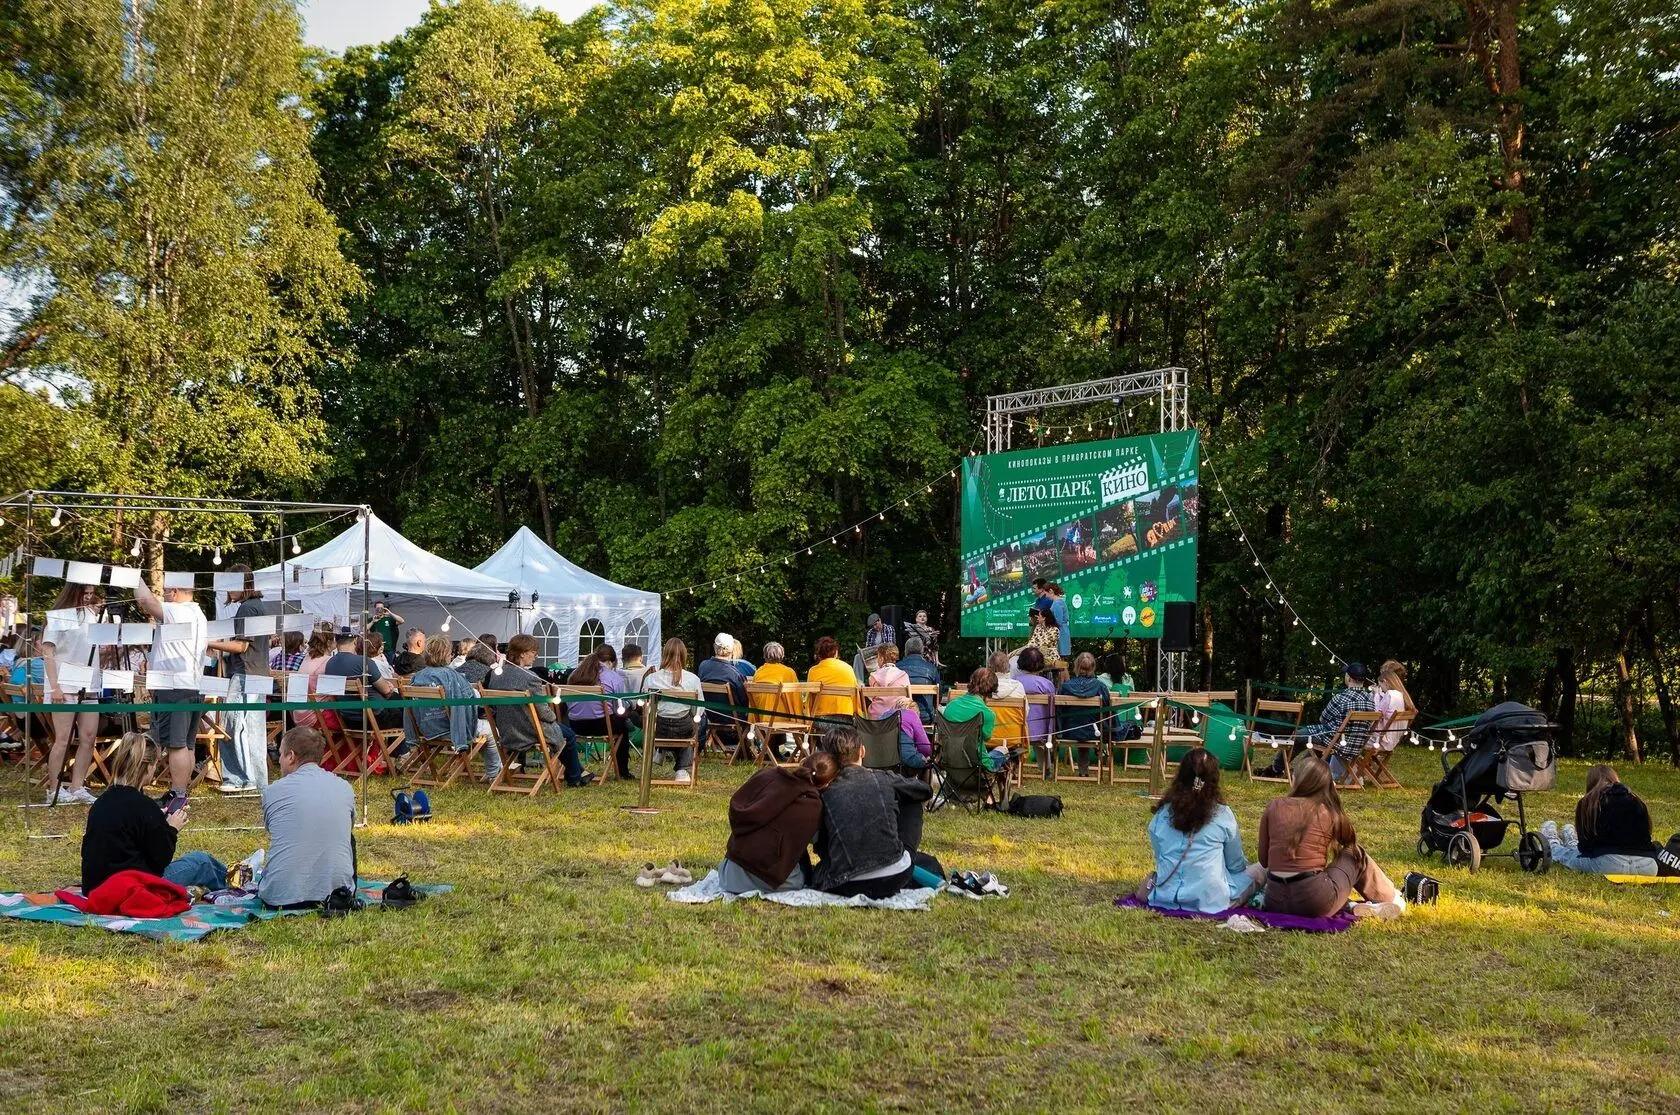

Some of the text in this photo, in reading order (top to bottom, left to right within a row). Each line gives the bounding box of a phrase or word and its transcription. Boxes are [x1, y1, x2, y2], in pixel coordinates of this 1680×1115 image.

[1008, 458, 1052, 468] КИНОПОКАЗЫ
[1062, 450, 1112, 462] ПРИОРАТСКОМ
[1115, 446, 1139, 456] ПАРКЕ
[1007, 470, 1147, 503] ЛЕТО. ПАРК. КИНО
